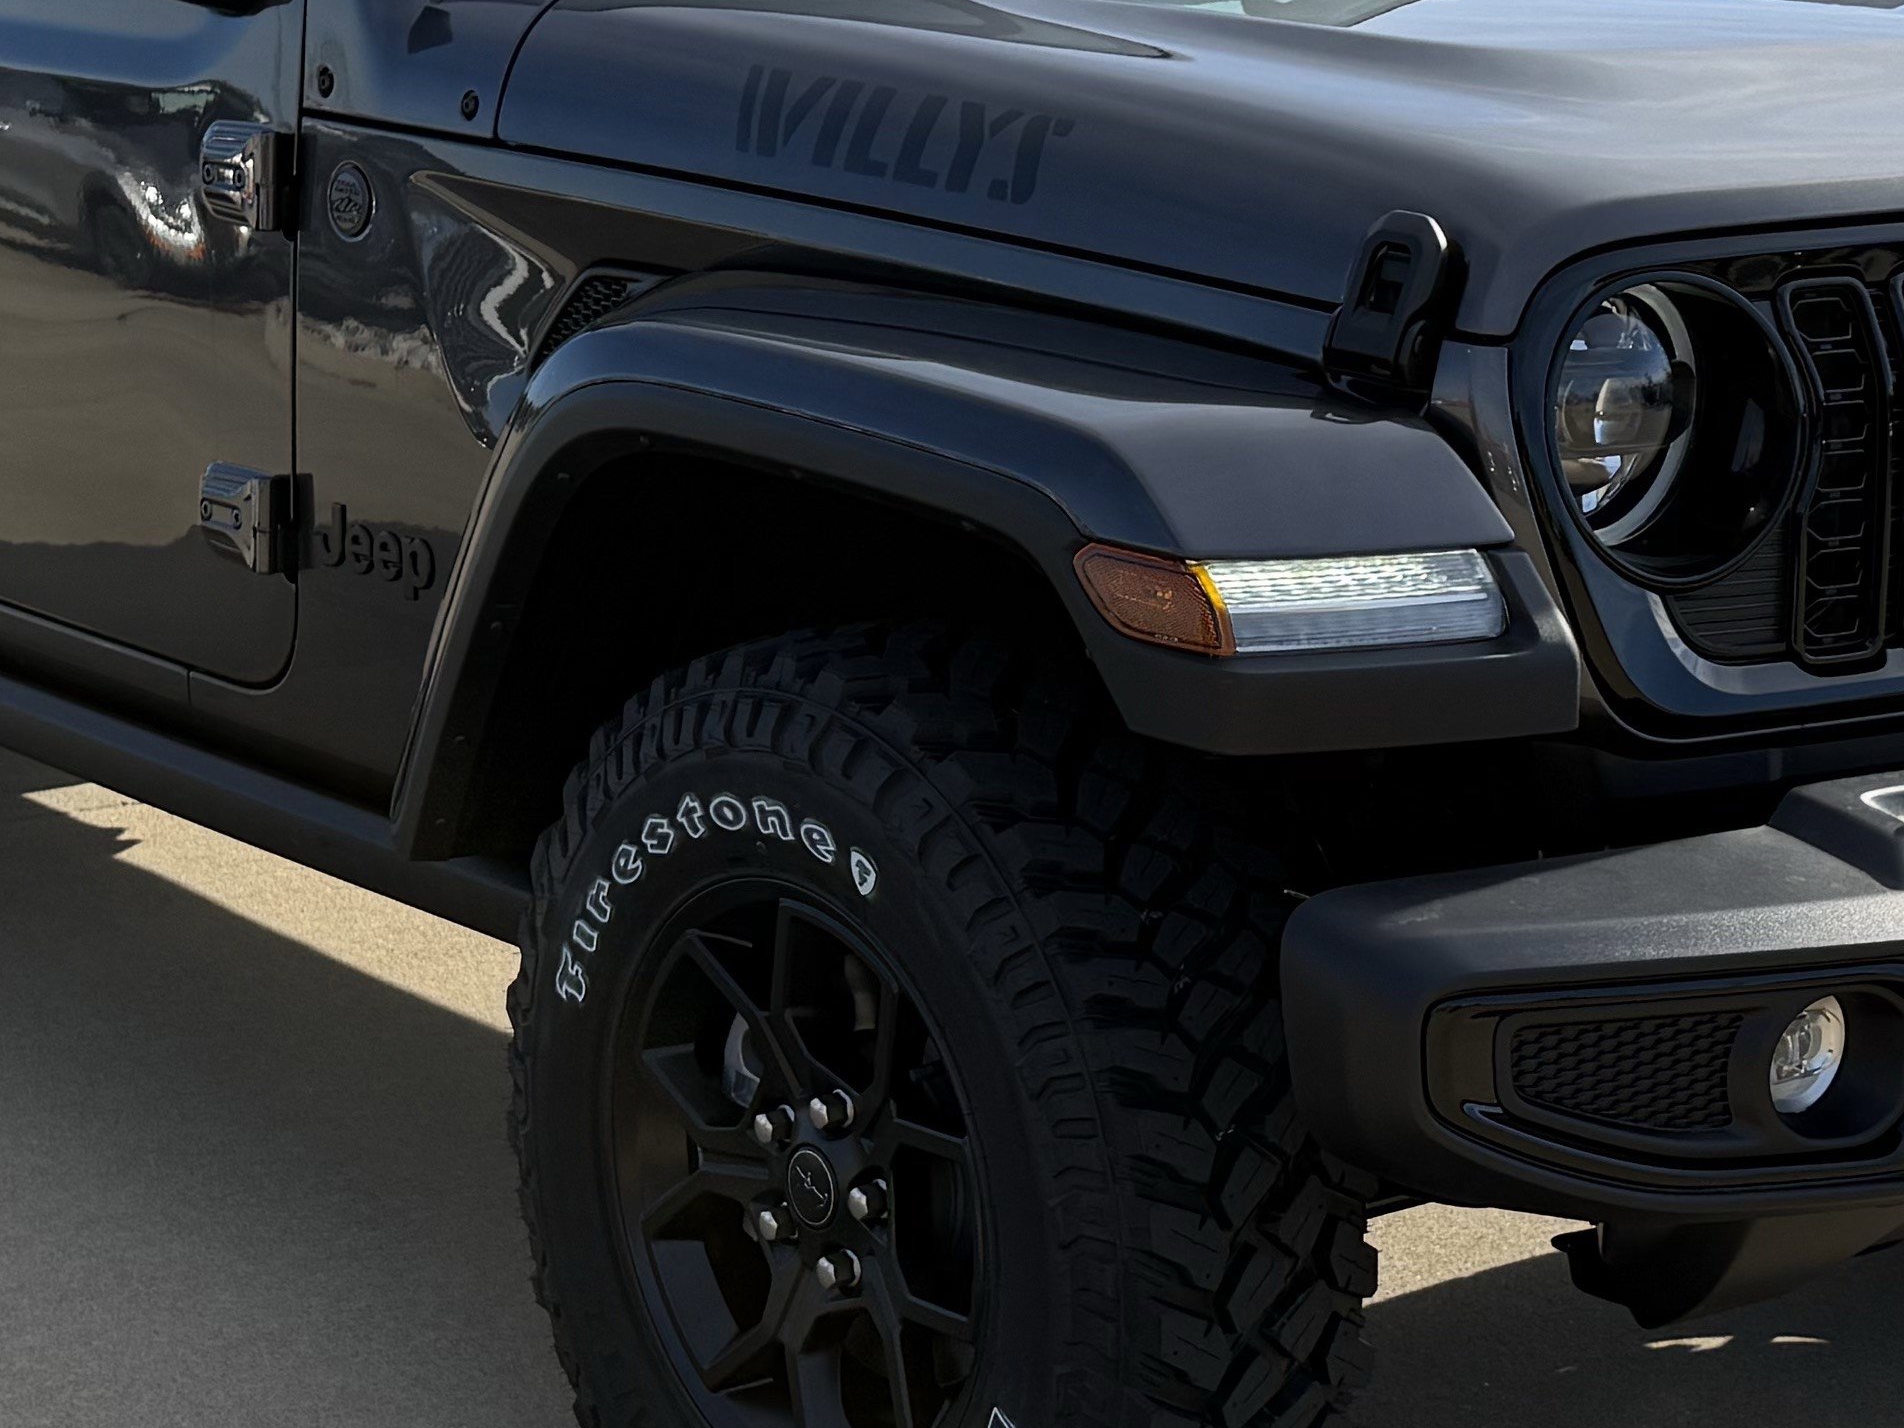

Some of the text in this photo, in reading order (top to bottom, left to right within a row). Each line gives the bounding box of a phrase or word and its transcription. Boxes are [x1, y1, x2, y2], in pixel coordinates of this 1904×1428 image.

[735, 63, 1076, 206] WILLYS
[314, 501, 436, 601] Jeep
[555, 789, 837, 1006] Firestone
